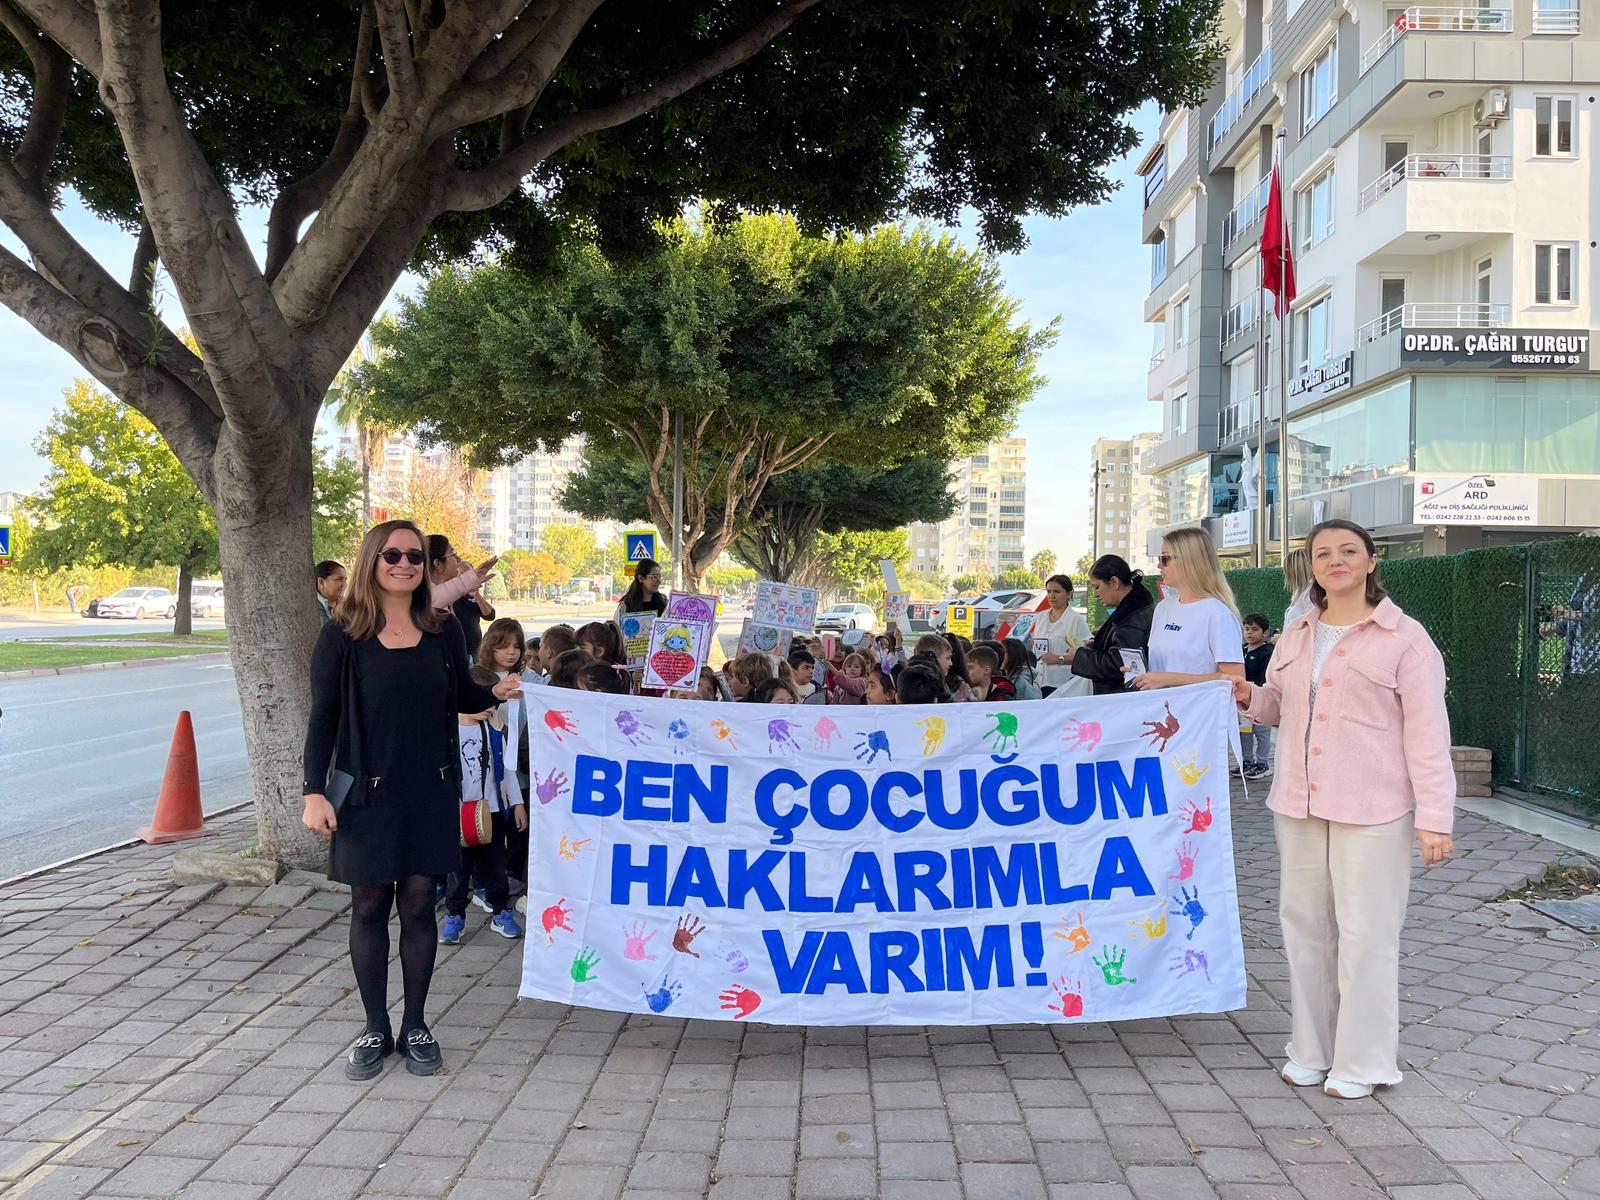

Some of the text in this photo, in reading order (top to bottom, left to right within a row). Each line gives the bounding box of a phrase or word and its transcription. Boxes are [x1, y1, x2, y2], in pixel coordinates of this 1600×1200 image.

[1404, 331, 1589, 356] OP.DR. ÇAĞRI TURGUT
[1511, 354, 1580, 364] 0552677 89 63
[1464, 491, 1488, 500] ARD
[956, 608, 965, 619] P
[571, 752, 1169, 846] BEN ÇOCUĞUM
[609, 836, 1156, 914] HAKLARIMLA
[761, 921, 1049, 996] VARIM!
